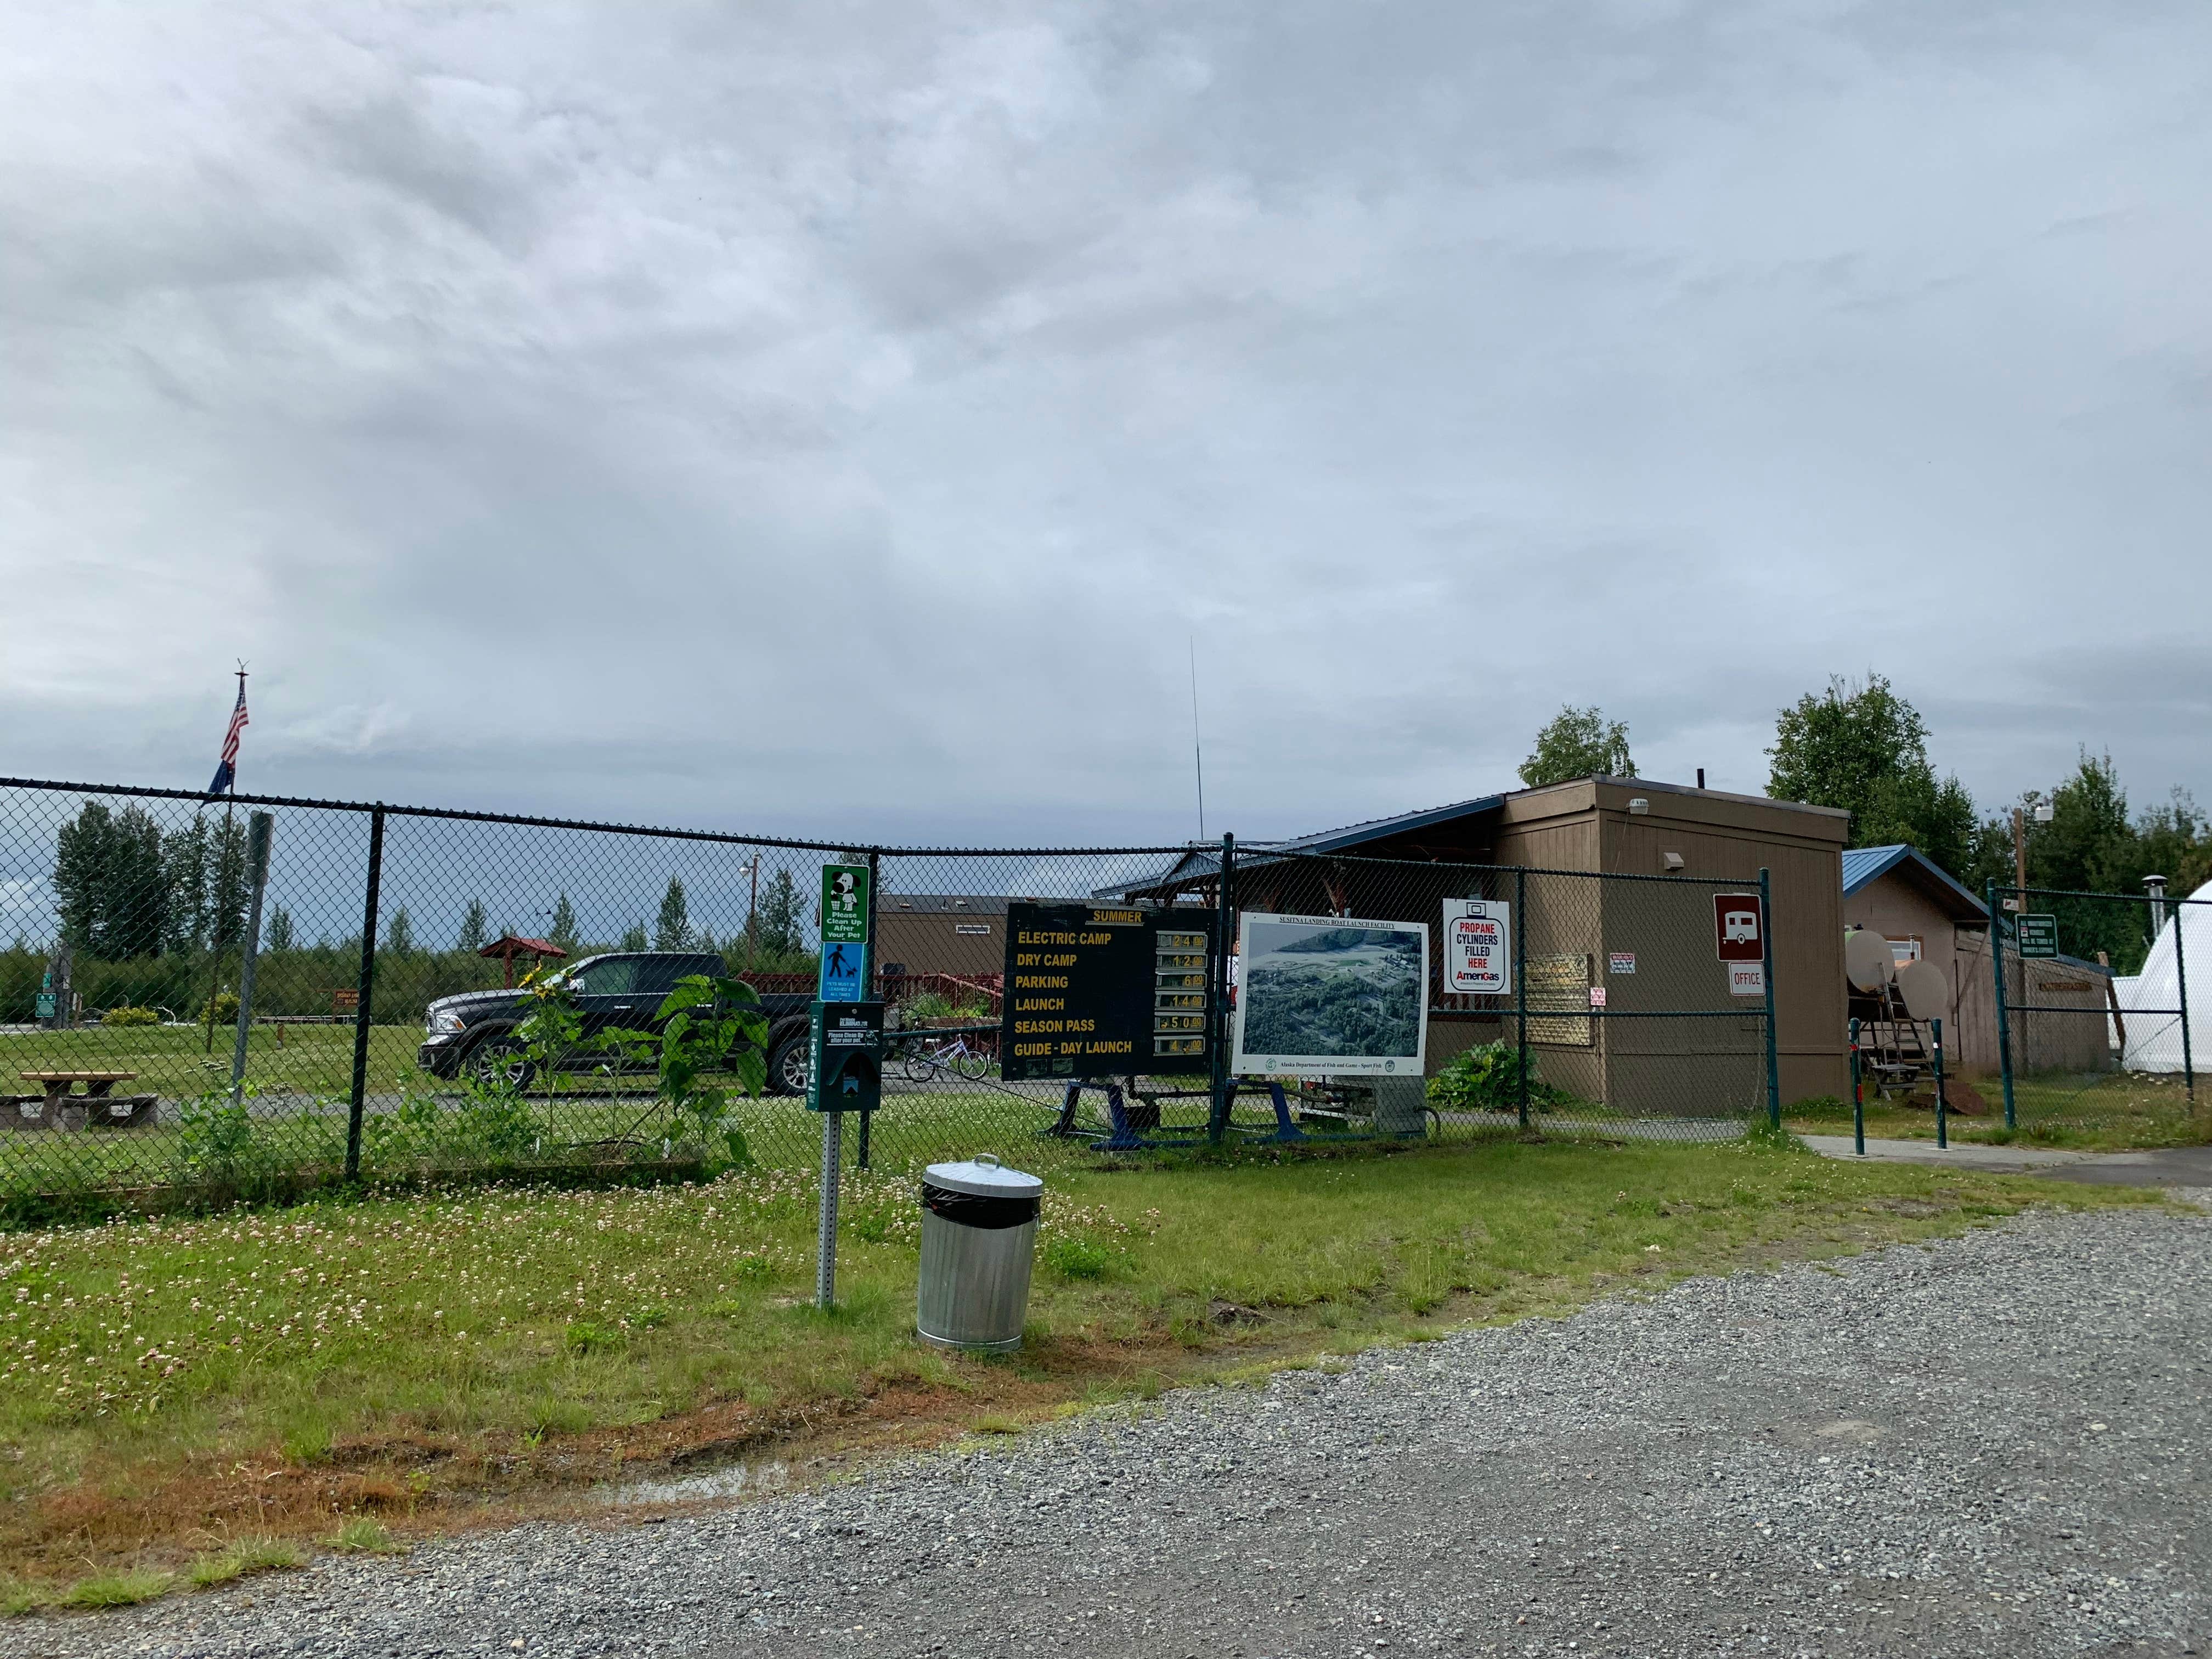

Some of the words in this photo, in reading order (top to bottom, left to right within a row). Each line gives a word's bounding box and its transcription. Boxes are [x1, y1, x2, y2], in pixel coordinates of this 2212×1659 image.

[1093, 910, 1142, 922] SUMMER
[1460, 922, 1495, 934] PROPANE
[1018, 932, 1076, 944] ELECTRIC
[1080, 933, 1111, 945] CAMP
[1457, 934, 1498, 945] CYLINDERS
[1465, 946, 1490, 956] FILLED
[1017, 953, 1041, 966] DRY
[1044, 954, 1077, 966] CAMP
[1468, 958, 1487, 968] HERE
[1457, 970, 1499, 981] AmeriGas
[1735, 973, 1760, 985] OFFICE
[1015, 976, 1068, 988] PARKING
[1015, 998, 1064, 1011] LAUNCH
[1015, 1020, 1063, 1033] SEASON
[1066, 1019, 1095, 1032] PASS
[1014, 1043, 1052, 1056] GUIDE
[1061, 1042, 1083, 1054] DAY
[1086, 1041, 1132, 1054] LAUNCH
